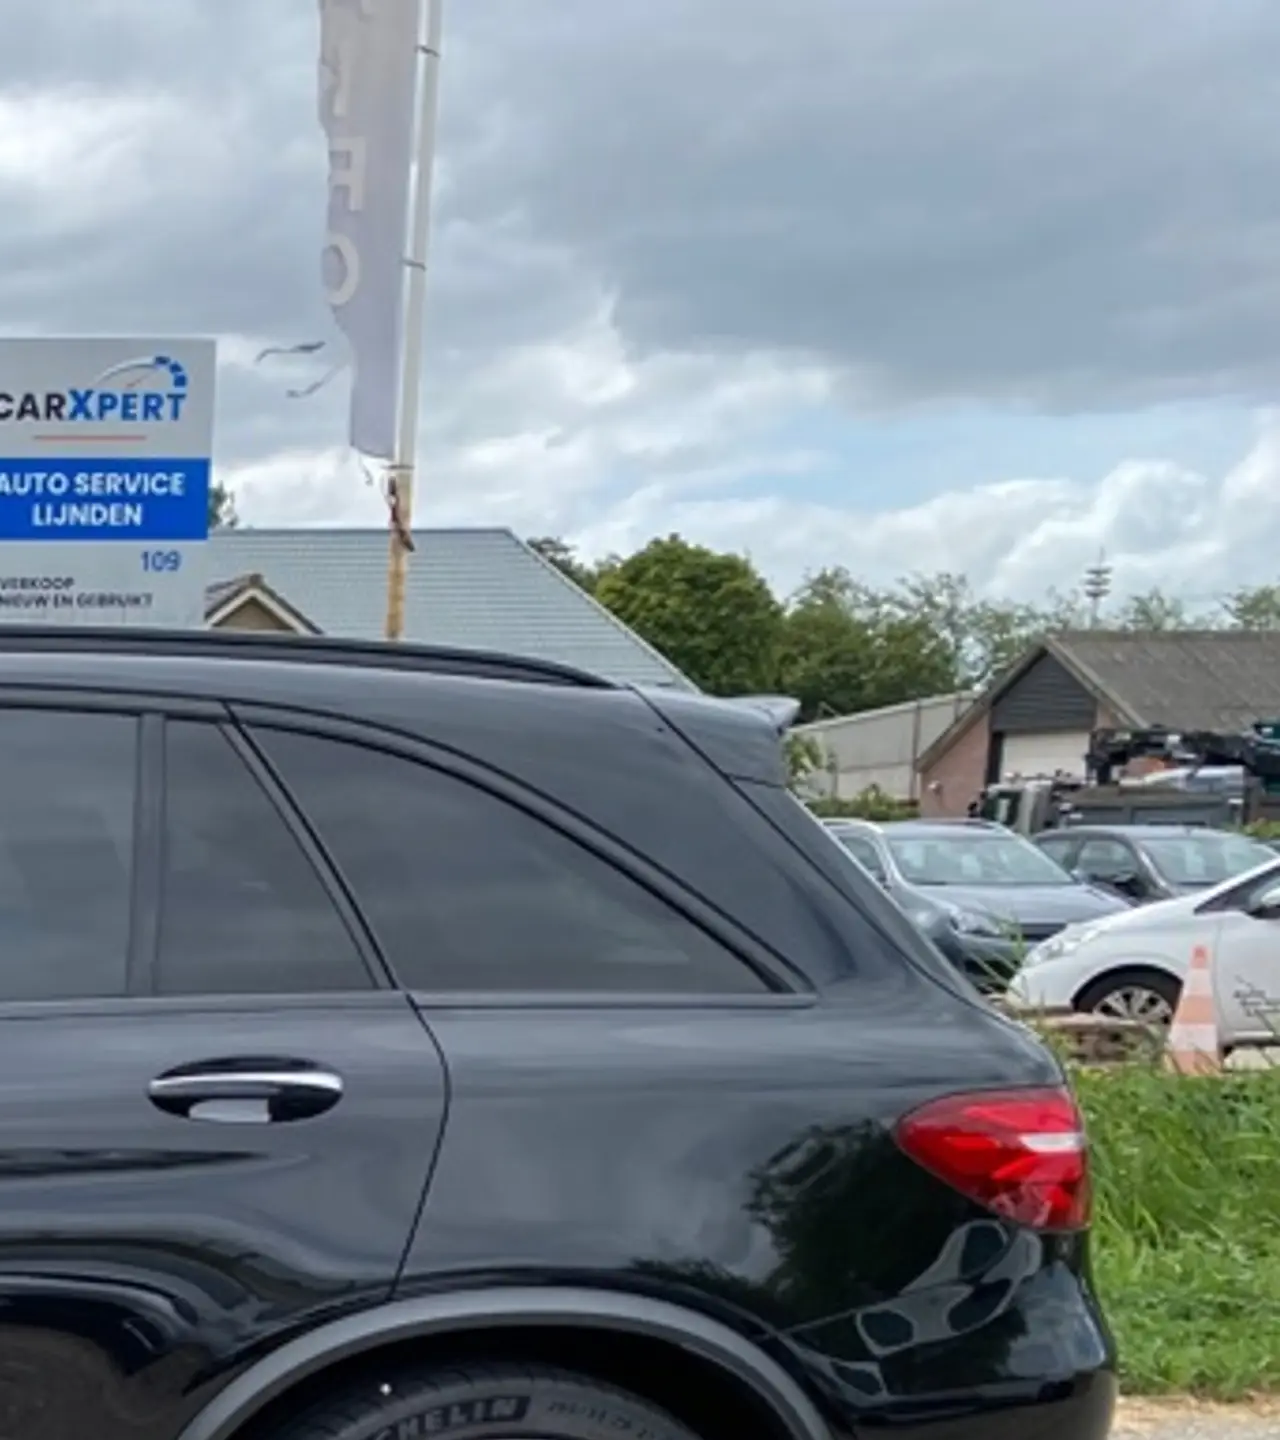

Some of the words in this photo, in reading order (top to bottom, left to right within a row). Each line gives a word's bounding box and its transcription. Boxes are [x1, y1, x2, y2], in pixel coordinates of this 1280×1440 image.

[72, 471, 187, 496] SERVICE
[31, 502, 143, 527] LIJNDEN
[141, 550, 181, 572] 109
